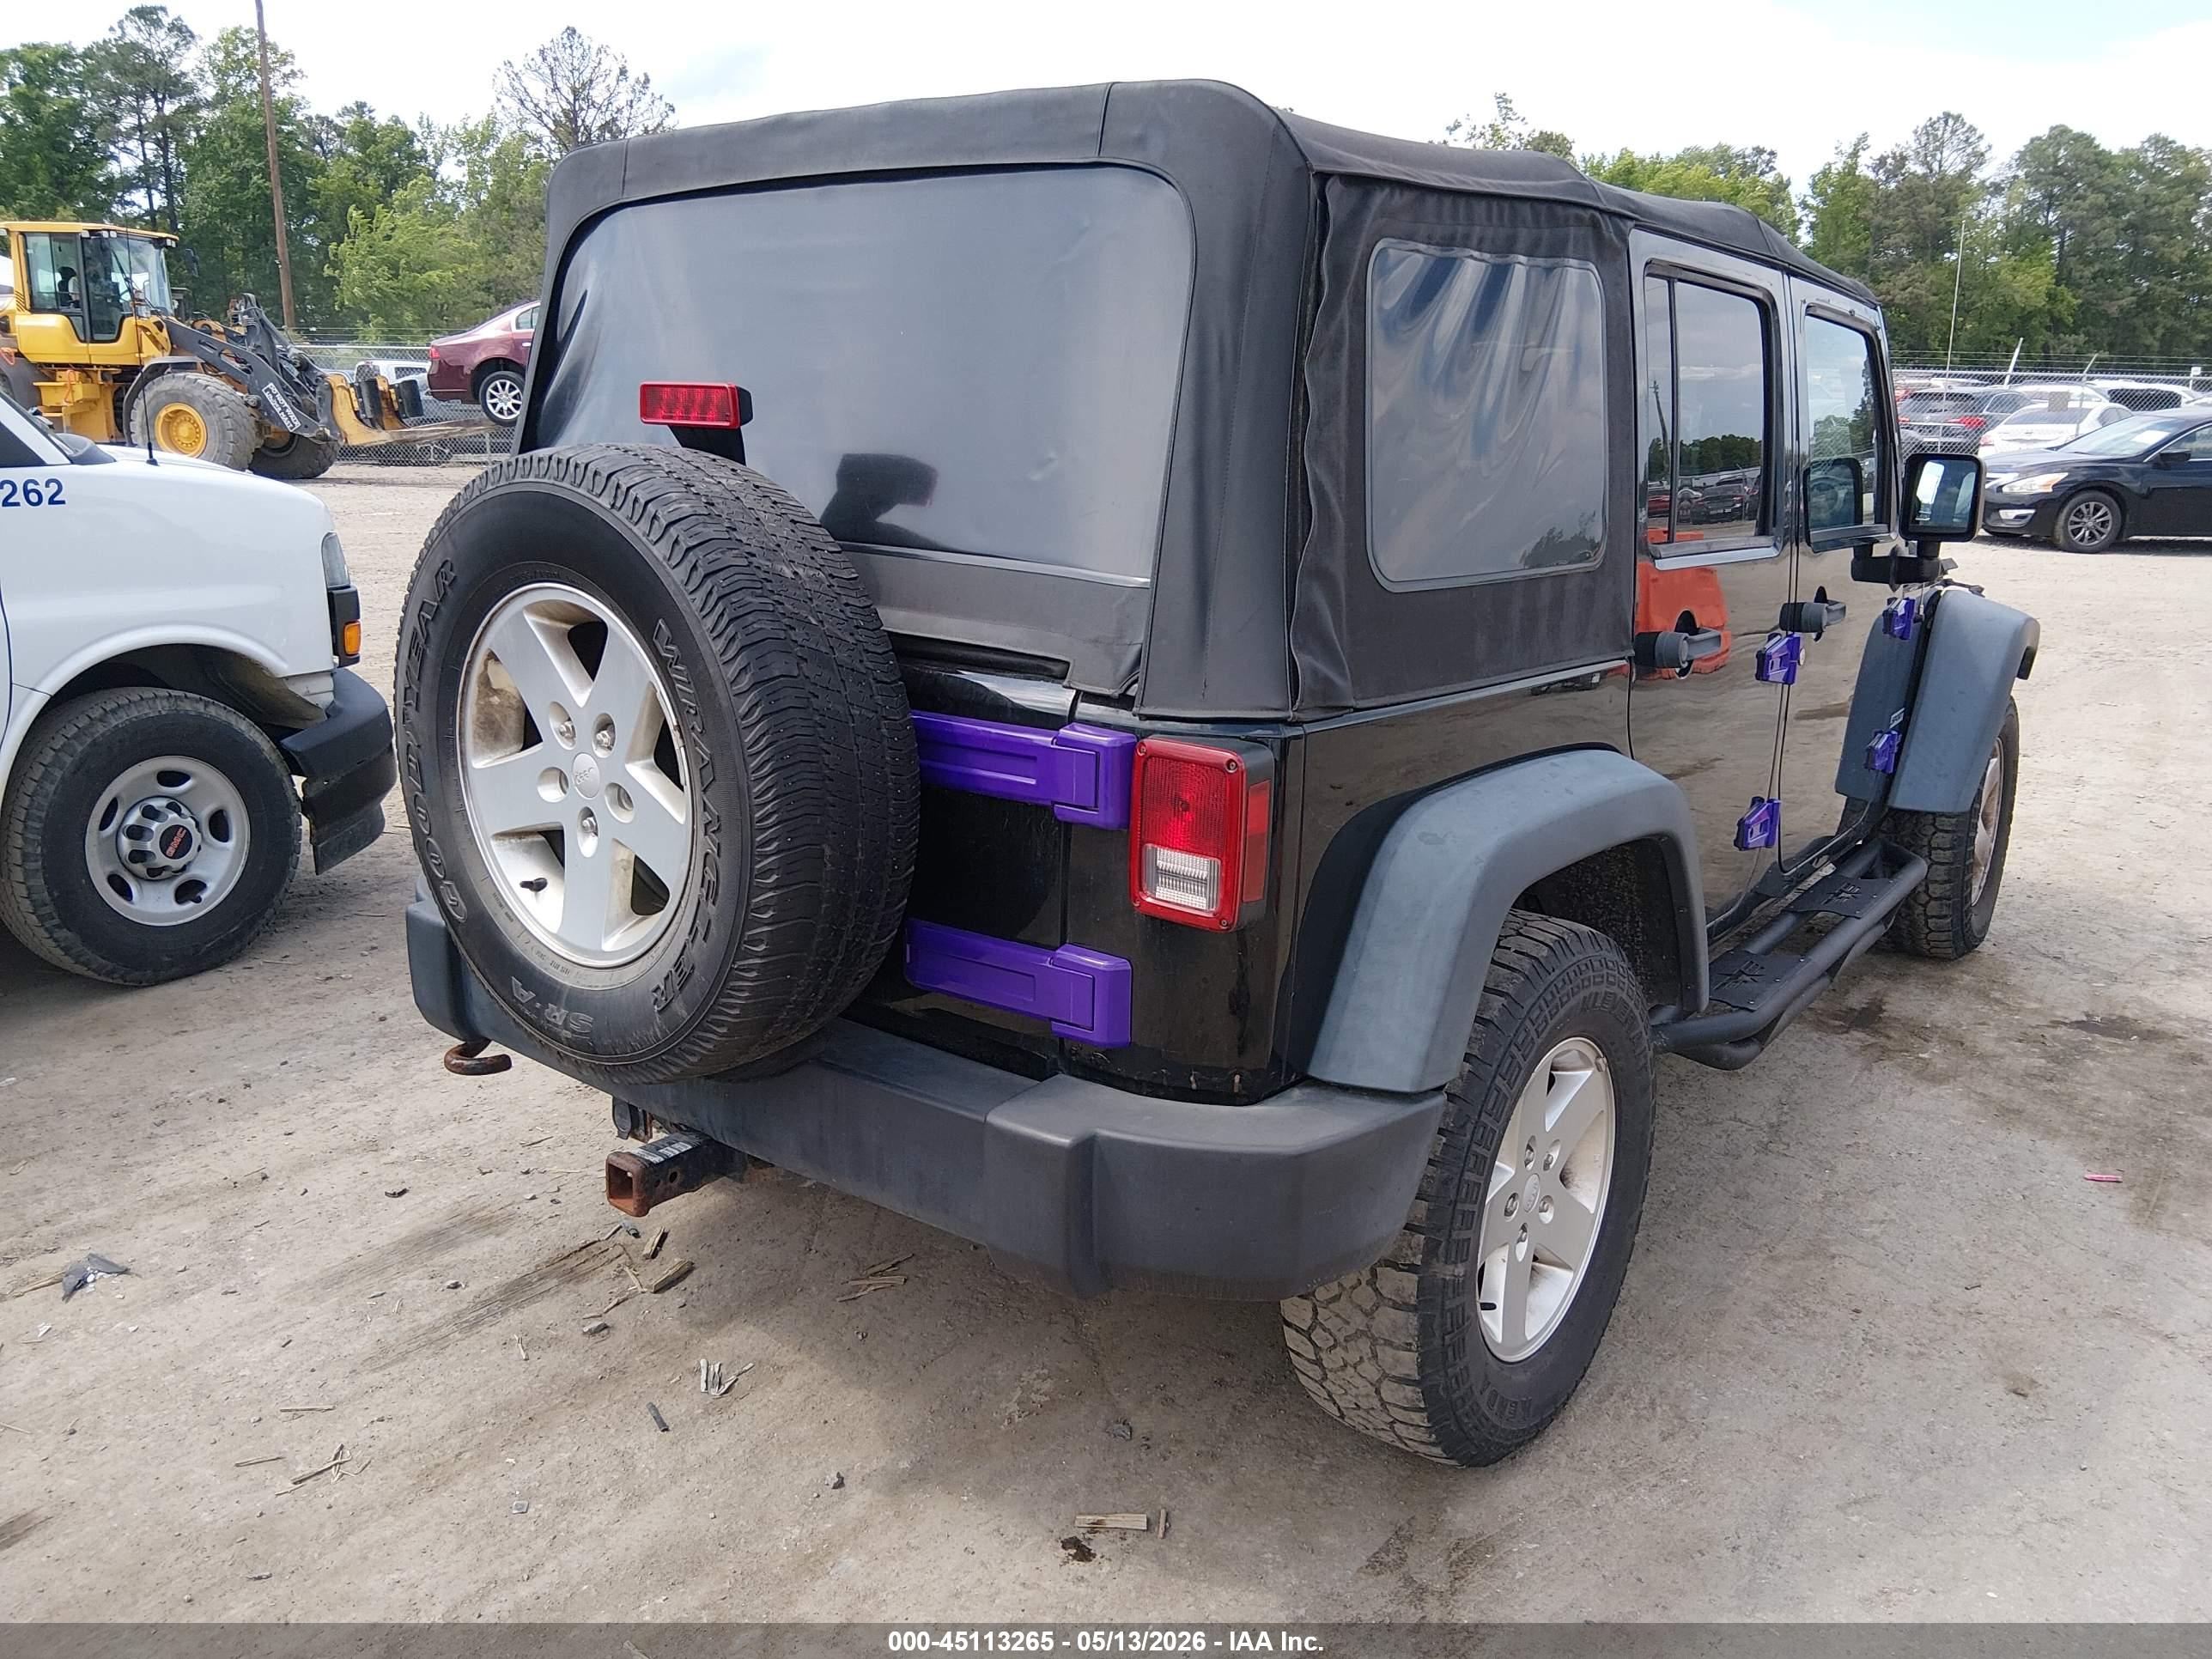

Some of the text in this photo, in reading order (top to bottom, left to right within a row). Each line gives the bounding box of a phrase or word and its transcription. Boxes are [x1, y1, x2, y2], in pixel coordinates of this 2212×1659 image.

[0, 477, 66, 507] 262
[402, 556, 468, 924] GOODYEAR
[652, 617, 721, 1013] WRANGLER
[166, 827, 186, 857] GMC
